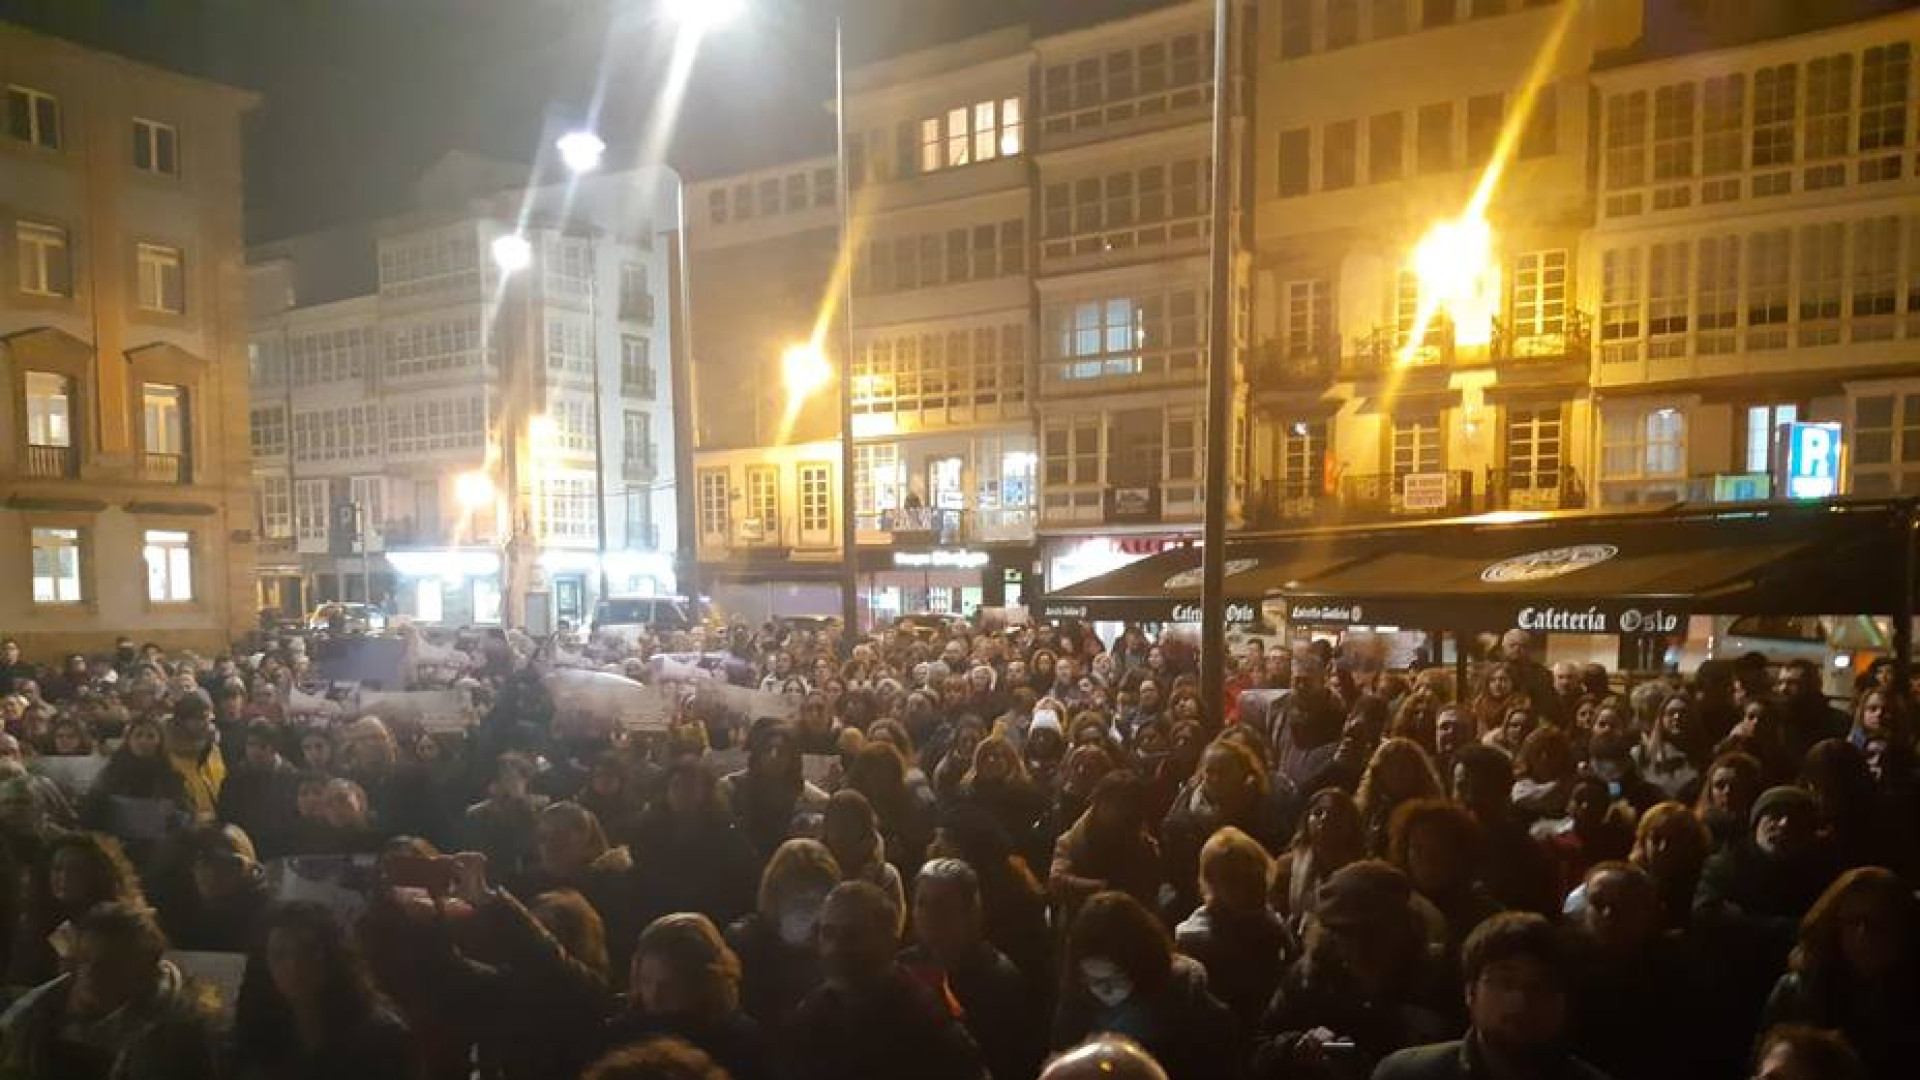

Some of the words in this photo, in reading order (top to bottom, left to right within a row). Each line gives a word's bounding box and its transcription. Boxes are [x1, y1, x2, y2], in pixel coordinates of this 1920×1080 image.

[1802, 428, 1829, 476] R
[1518, 606, 1605, 630] Cafetería
[1620, 608, 1677, 631] Oslo
